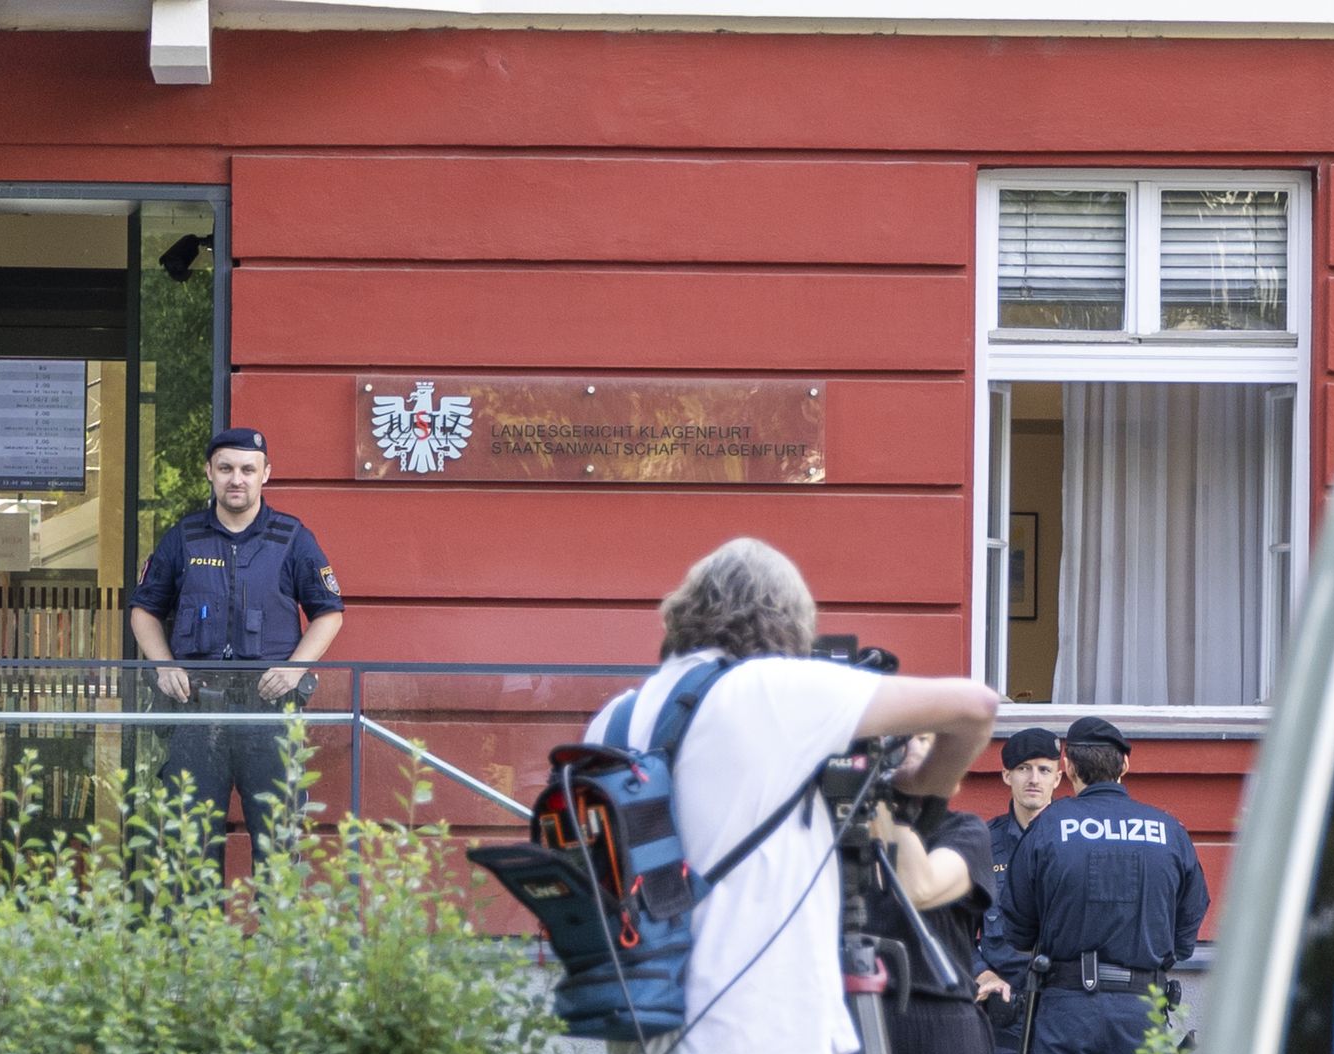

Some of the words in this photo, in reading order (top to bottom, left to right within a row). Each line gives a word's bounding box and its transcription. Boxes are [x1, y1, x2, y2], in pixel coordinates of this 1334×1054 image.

[491, 424, 634, 438] LANDESGERICHT
[639, 425, 751, 439] KLAGENFURT
[491, 441, 690, 456] STAATSANWALTSCHAFT
[695, 443, 808, 457] KLAGENFURT
[190, 557, 225, 567] POLIZEI
[828, 757, 853, 768] PULS
[1060, 818, 1167, 844] POLIZEI
